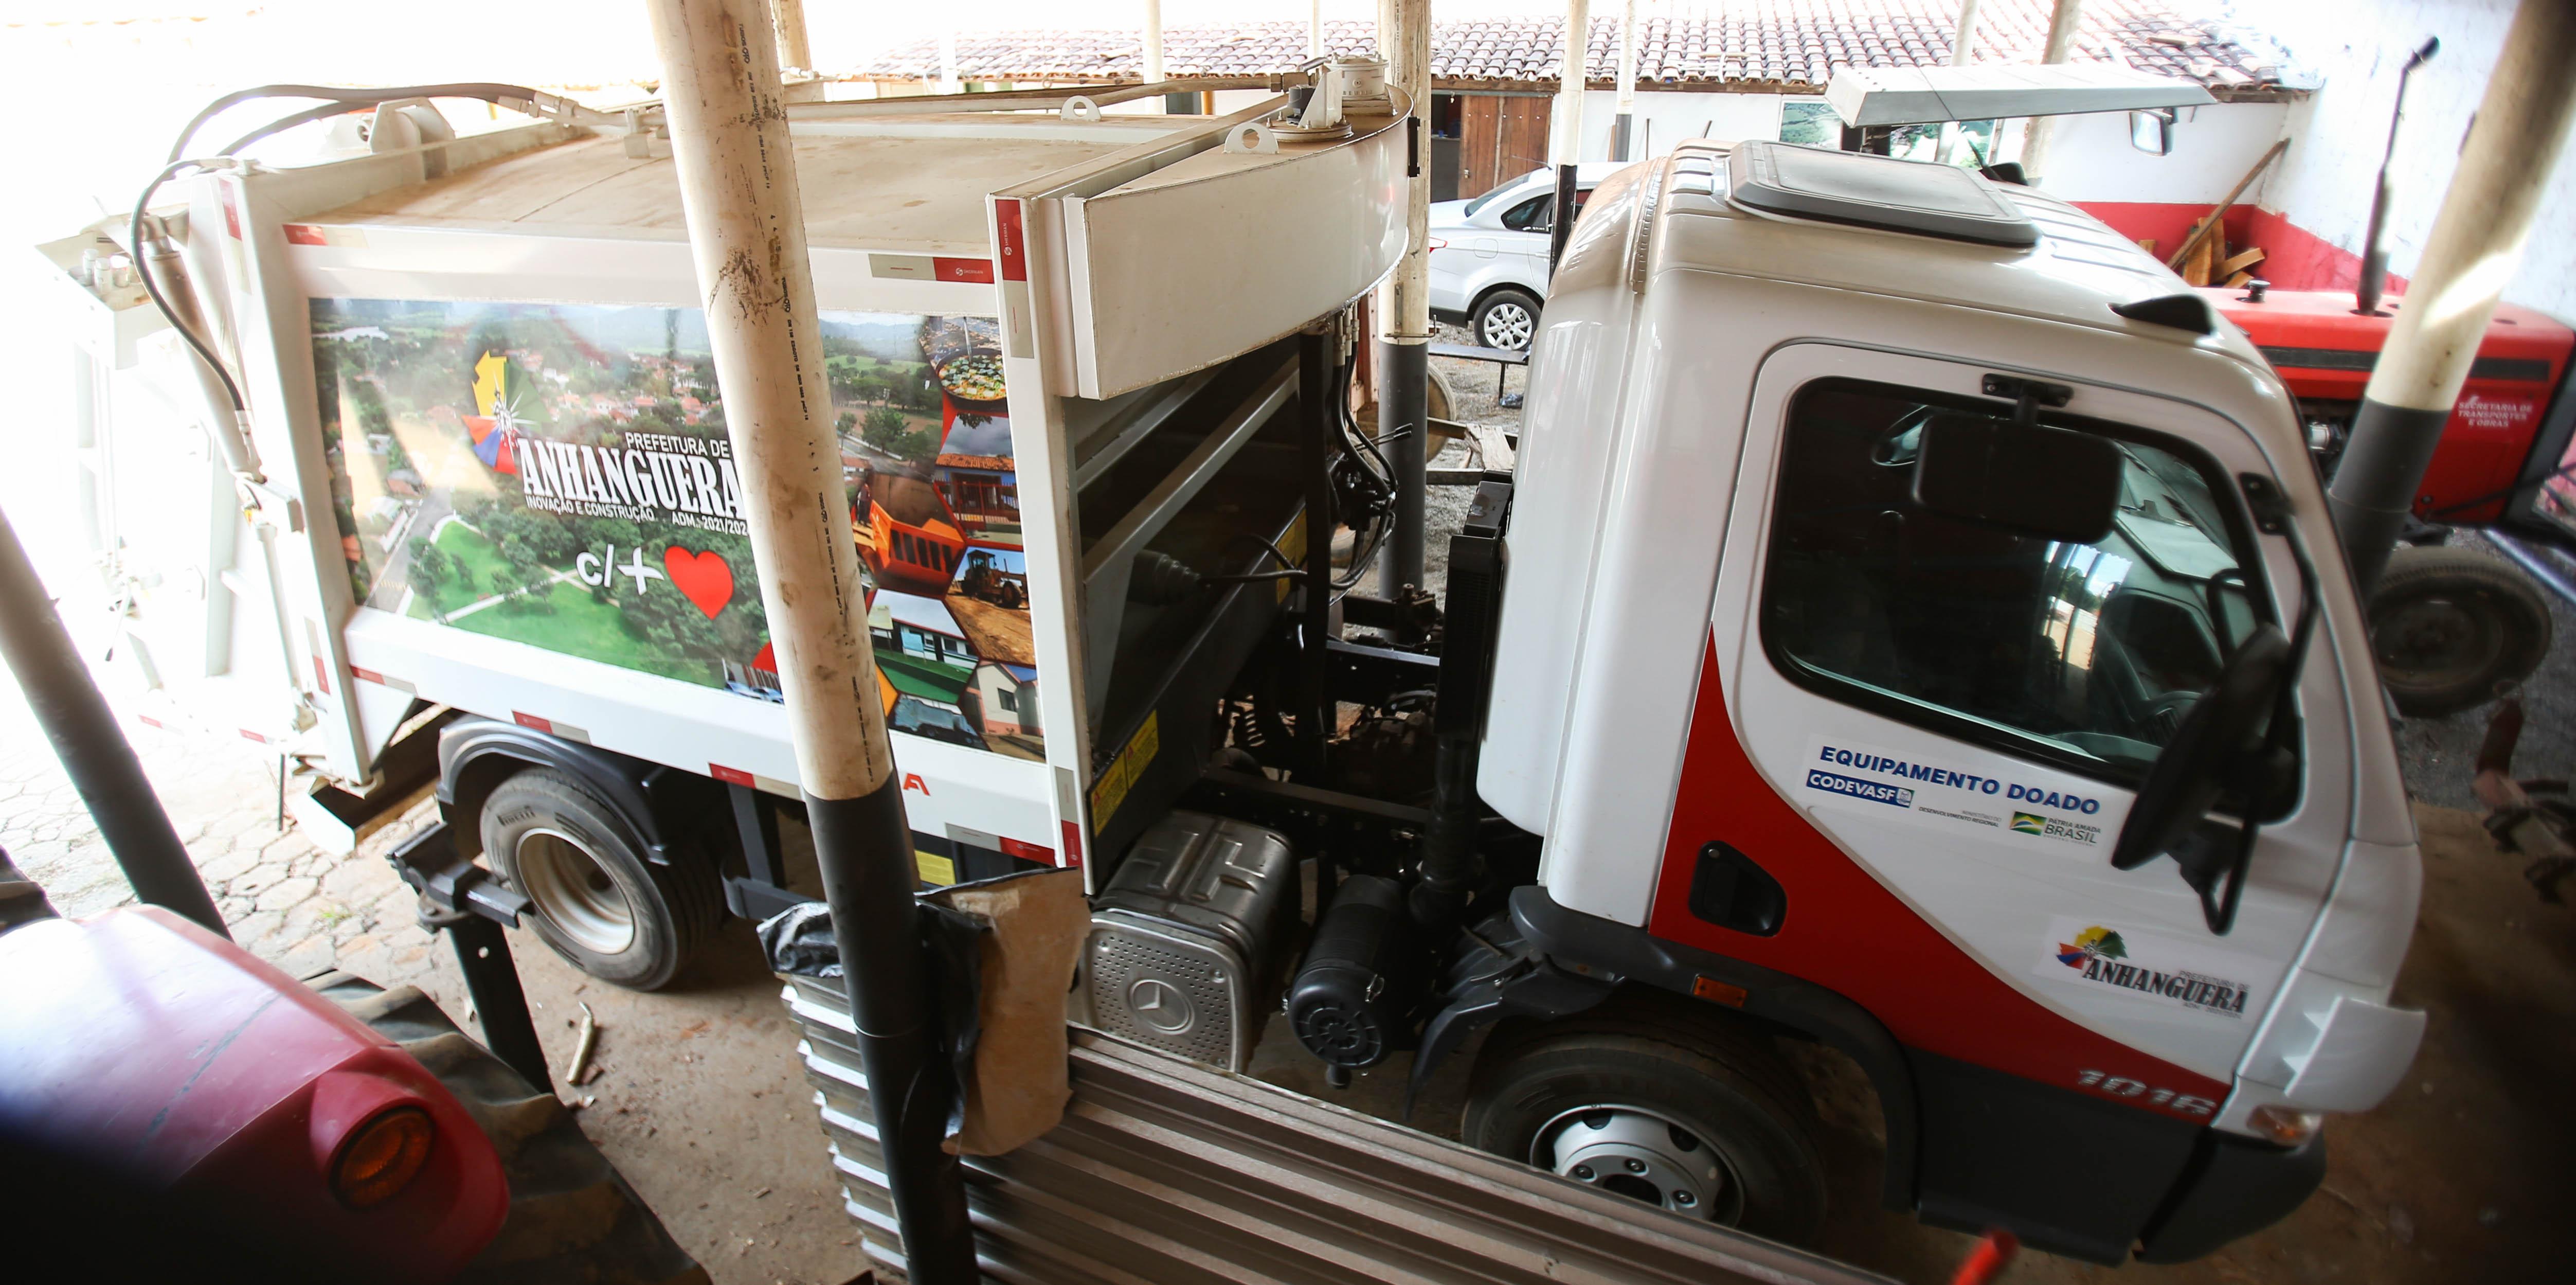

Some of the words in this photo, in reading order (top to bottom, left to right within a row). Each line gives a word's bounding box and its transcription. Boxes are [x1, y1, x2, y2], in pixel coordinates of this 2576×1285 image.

[739, 23, 748, 46] TUBOS
[790, 340, 799, 362] ESGOTO
[2458, 402, 2516, 412] SECRETARIA
[2458, 411, 2527, 420] TRANSPORTES
[2477, 420, 2509, 428] OBRAS
[625, 432, 706, 456] PREFEITURA
[710, 439, 730, 458] DE
[516, 437, 747, 520] ANHANGUERA
[525, 495, 574, 515] INOVAÇÃO
[575, 501, 584, 515] E
[584, 502, 655, 523] CONSTRUÇÃO
[1808, 774, 1896, 801] CODEVASF
[1820, 746, 2001, 796] EQUIPAMENTO
[2007, 783, 2100, 816] DOADO
[1918, 806, 1971, 822] DESENVOLVIMENTO
[1972, 817, 1999, 827] REGIONAL
[2044, 825, 2097, 844] BRASIL
[2075, 823, 2101, 834] AMADA
[2082, 958, 2248, 1013] ANHANGUERA
[2077, 1069, 2218, 1115] 1016
